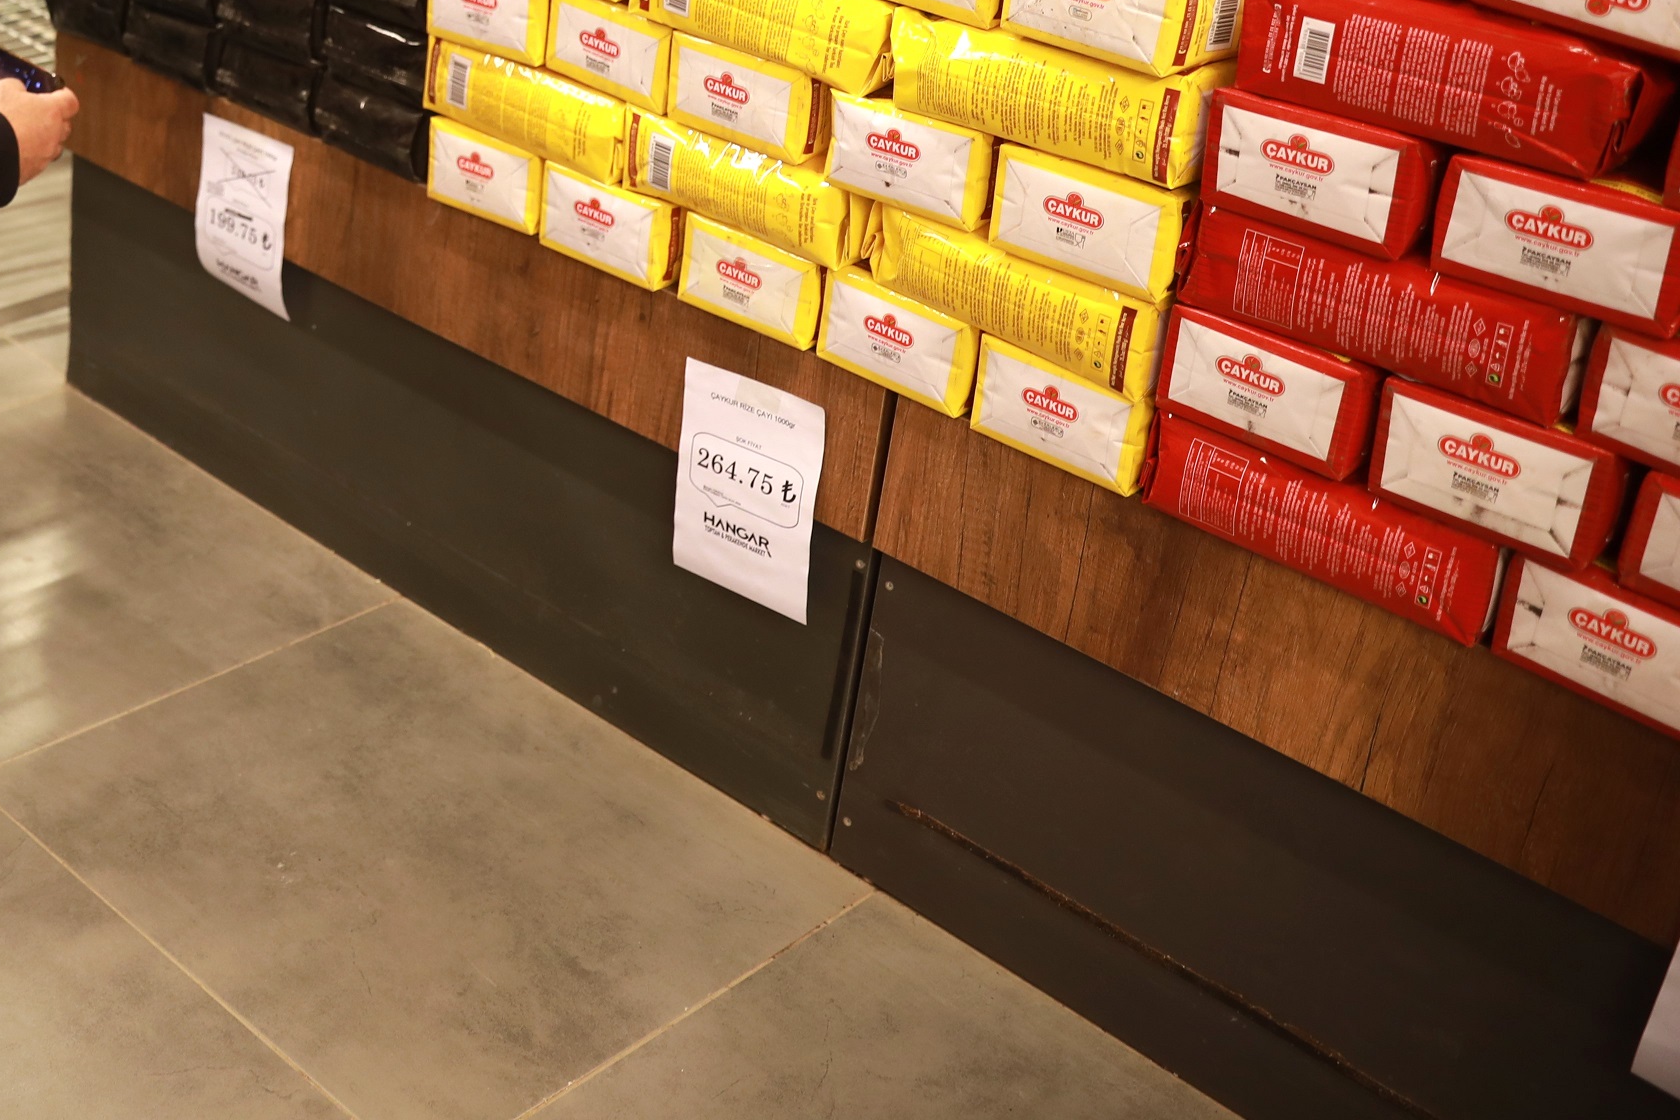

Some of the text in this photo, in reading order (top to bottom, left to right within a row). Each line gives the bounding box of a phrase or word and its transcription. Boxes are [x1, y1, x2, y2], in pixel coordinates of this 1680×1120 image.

[706, 79, 747, 102] ÇAYKUR
[869, 135, 920, 160] ÇAYKUR
[1266, 143, 1329, 171] ÇAYKUR
[1269, 163, 1324, 182] www.caykur.gov.tr
[210, 208, 258, 245] 199.75
[1048, 200, 1099, 226] ÇAYKUR
[1048, 216, 1094, 236] www.caykur.gov.tr
[1512, 214, 1587, 246] ÇAYKUR
[1515, 235, 1580, 257] www.caykur.gov.tr
[866, 318, 911, 345] ÇAYKUR
[1221, 360, 1280, 393] ÇAYKUR
[1223, 379, 1274, 402] www.caykur.gov.tr
[710, 392, 739, 407] ÇAYKUR
[739, 401, 755, 414] RİZE
[756, 409, 773, 421] ÇAYI
[1026, 391, 1074, 419] ÇAYKUR
[697, 447, 774, 496] 264.75
[1444, 439, 1514, 476] ÇAYKUR
[1446, 459, 1508, 486] www.caykur.gov.tr
[704, 511, 771, 558] HANGAR
[1575, 612, 1650, 655] ÇAYKUR
